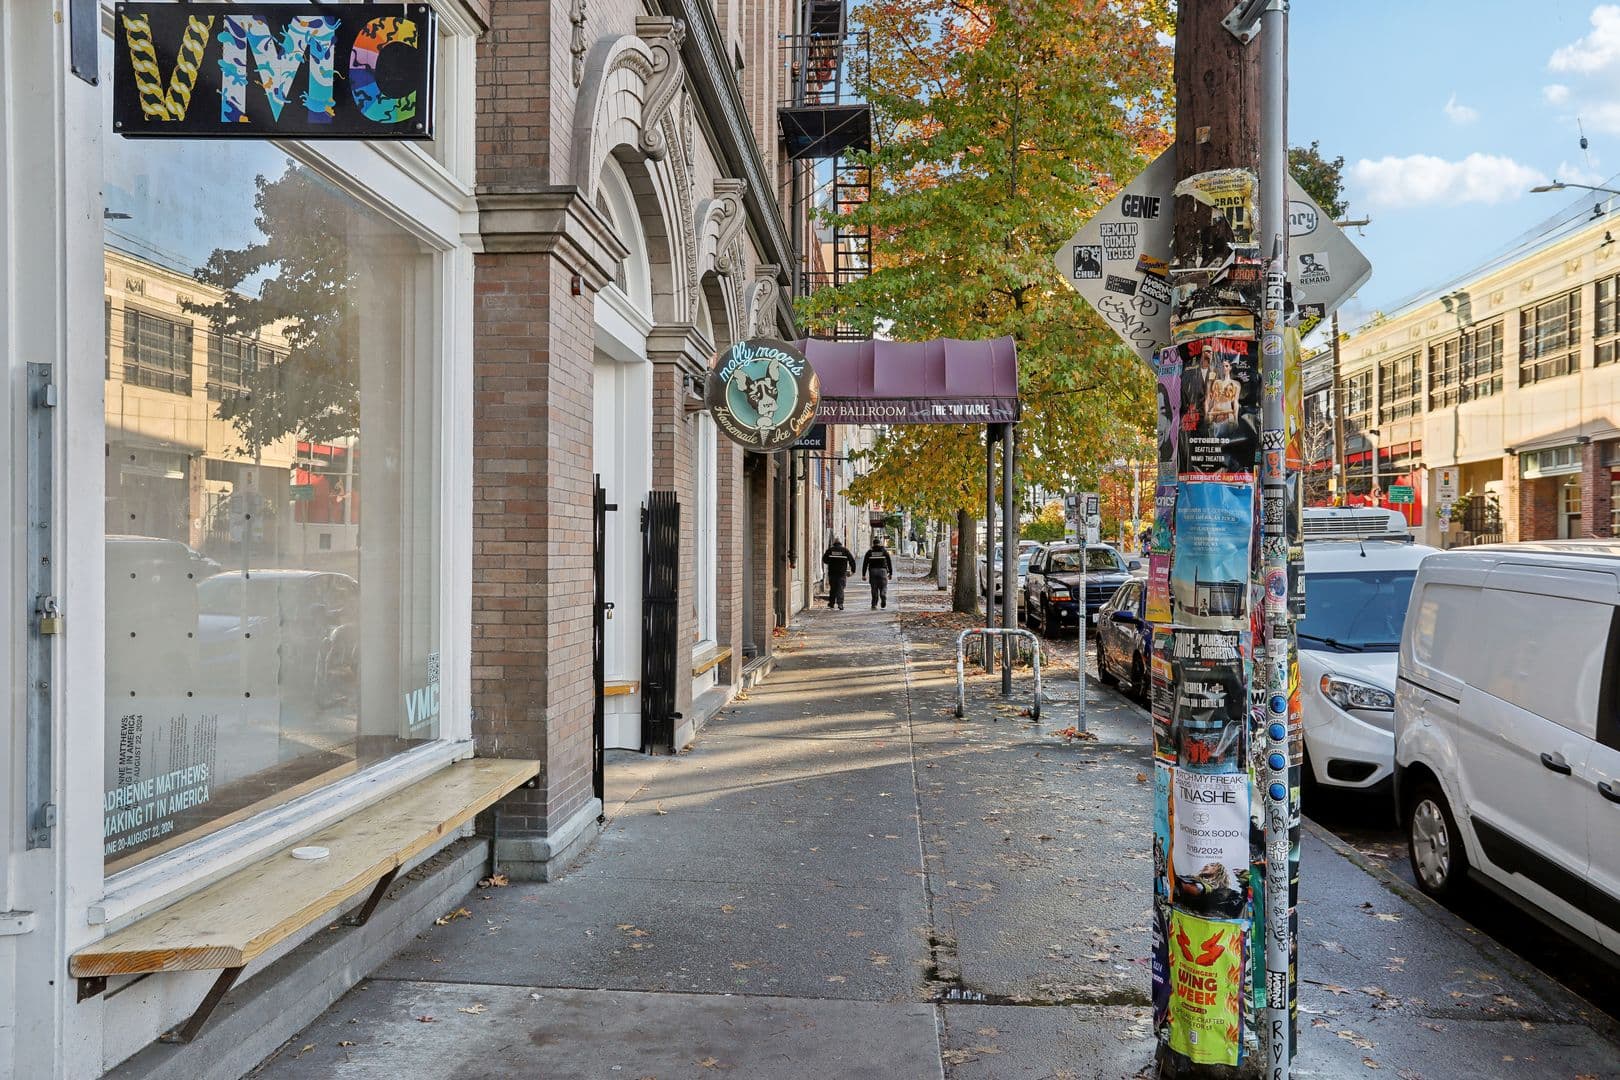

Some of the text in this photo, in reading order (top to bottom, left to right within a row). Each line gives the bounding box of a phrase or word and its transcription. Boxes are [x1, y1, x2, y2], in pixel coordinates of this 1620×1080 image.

[121, 14, 418, 124] VMC
[1121, 194, 1160, 219] GENIE
[1100, 222, 1138, 236] REMAND
[1104, 236, 1136, 248] GUMBA
[1106, 247, 1135, 260] TCU33
[1300, 276, 1330, 285] REMAND
[720, 341, 755, 382] molly
[840, 406, 906, 417] BALLROOM
[931, 405, 946, 415] THE
[965, 404, 990, 415] TABLE
[714, 402, 813, 444] Homemade Ice Cream
[1198, 634, 1238, 648] MANCHESTER
[1200, 646, 1239, 660] ORCHESTRA
[405, 682, 440, 726] VMC
[1194, 775, 1209, 783] MY
[103, 777, 154, 813] ADRIENNE
[156, 762, 209, 796] MATTHEWS:
[145, 801, 154, 823] IT
[156, 797, 167, 819] IN
[168, 784, 210, 815] AMERICA
[1212, 830, 1239, 838] SODO
[1178, 968, 1217, 991] WING
[1177, 983, 1217, 1005] WEEK
